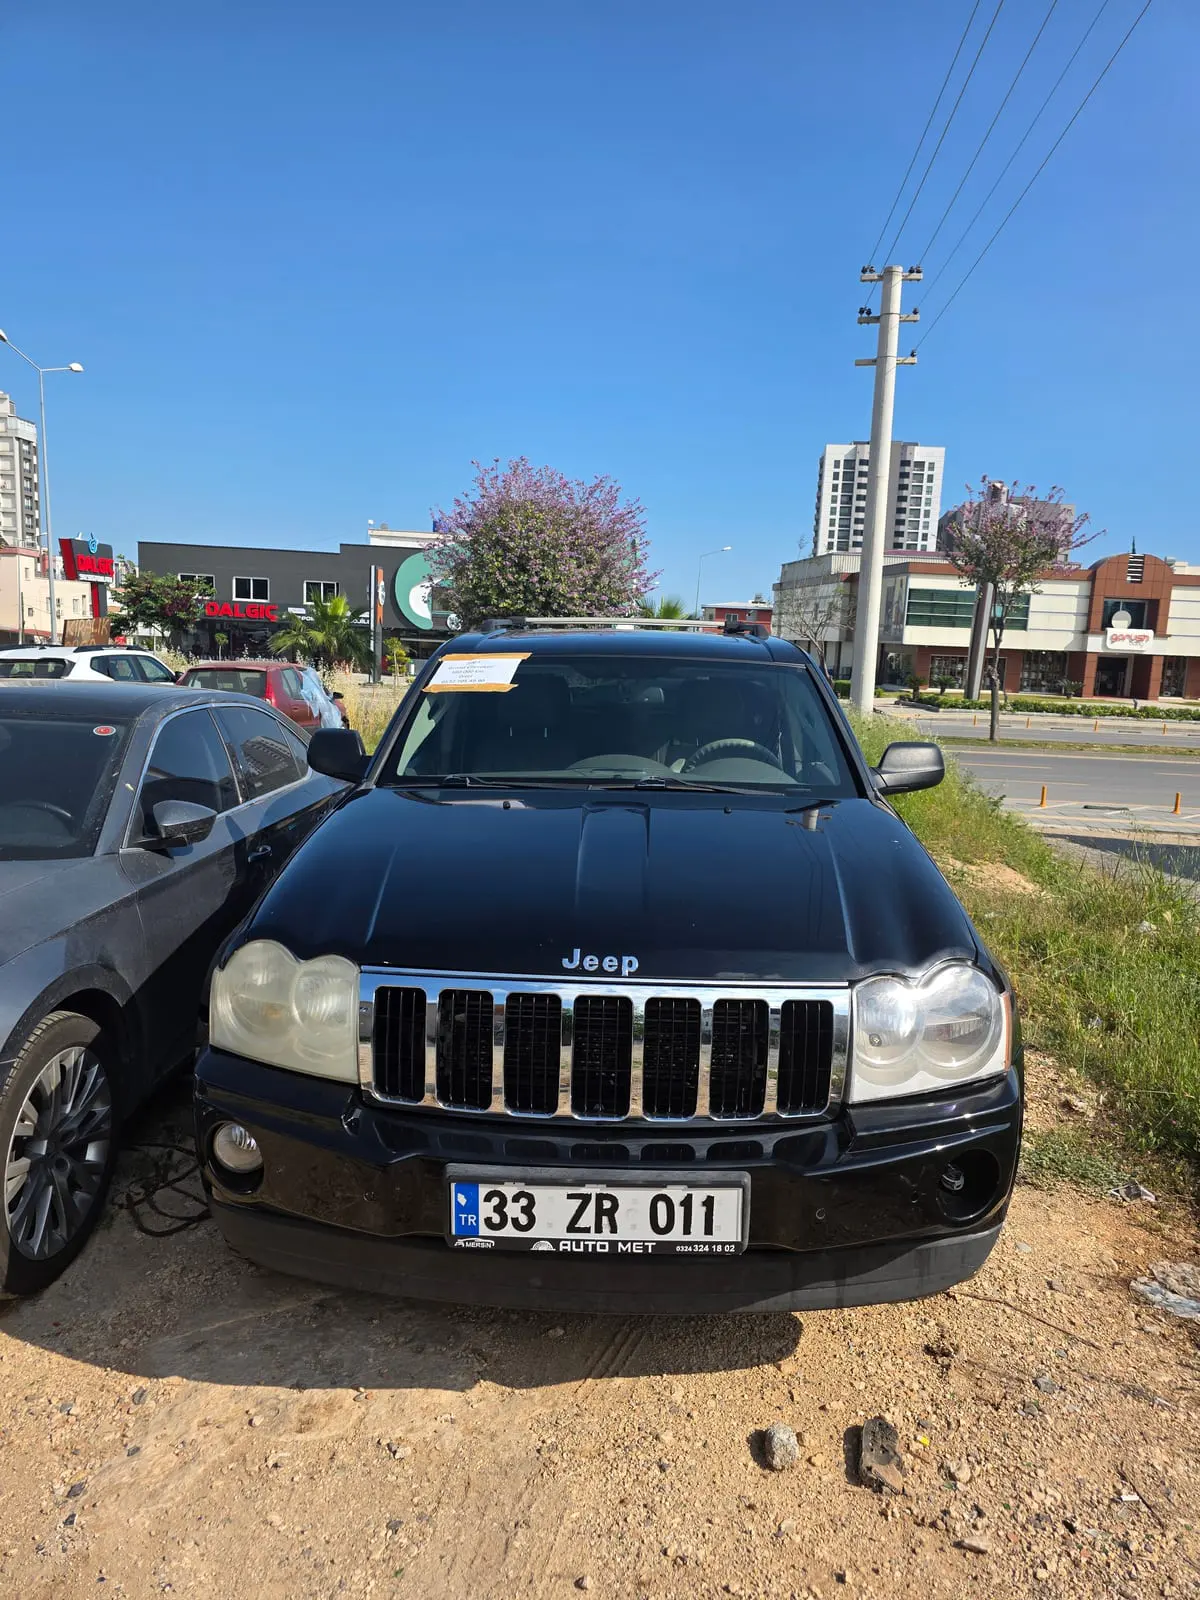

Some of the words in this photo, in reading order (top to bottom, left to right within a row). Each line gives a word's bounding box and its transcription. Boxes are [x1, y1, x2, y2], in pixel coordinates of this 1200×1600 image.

[205, 602, 279, 623] DALGIÇ
[561, 948, 639, 977] Jeep
[459, 1214, 477, 1226] TR
[483, 1189, 536, 1232] 33
[566, 1192, 619, 1234] ZR
[649, 1193, 715, 1236] 011
[559, 1240, 610, 1253] AUTO
[617, 1242, 657, 1253] MET
